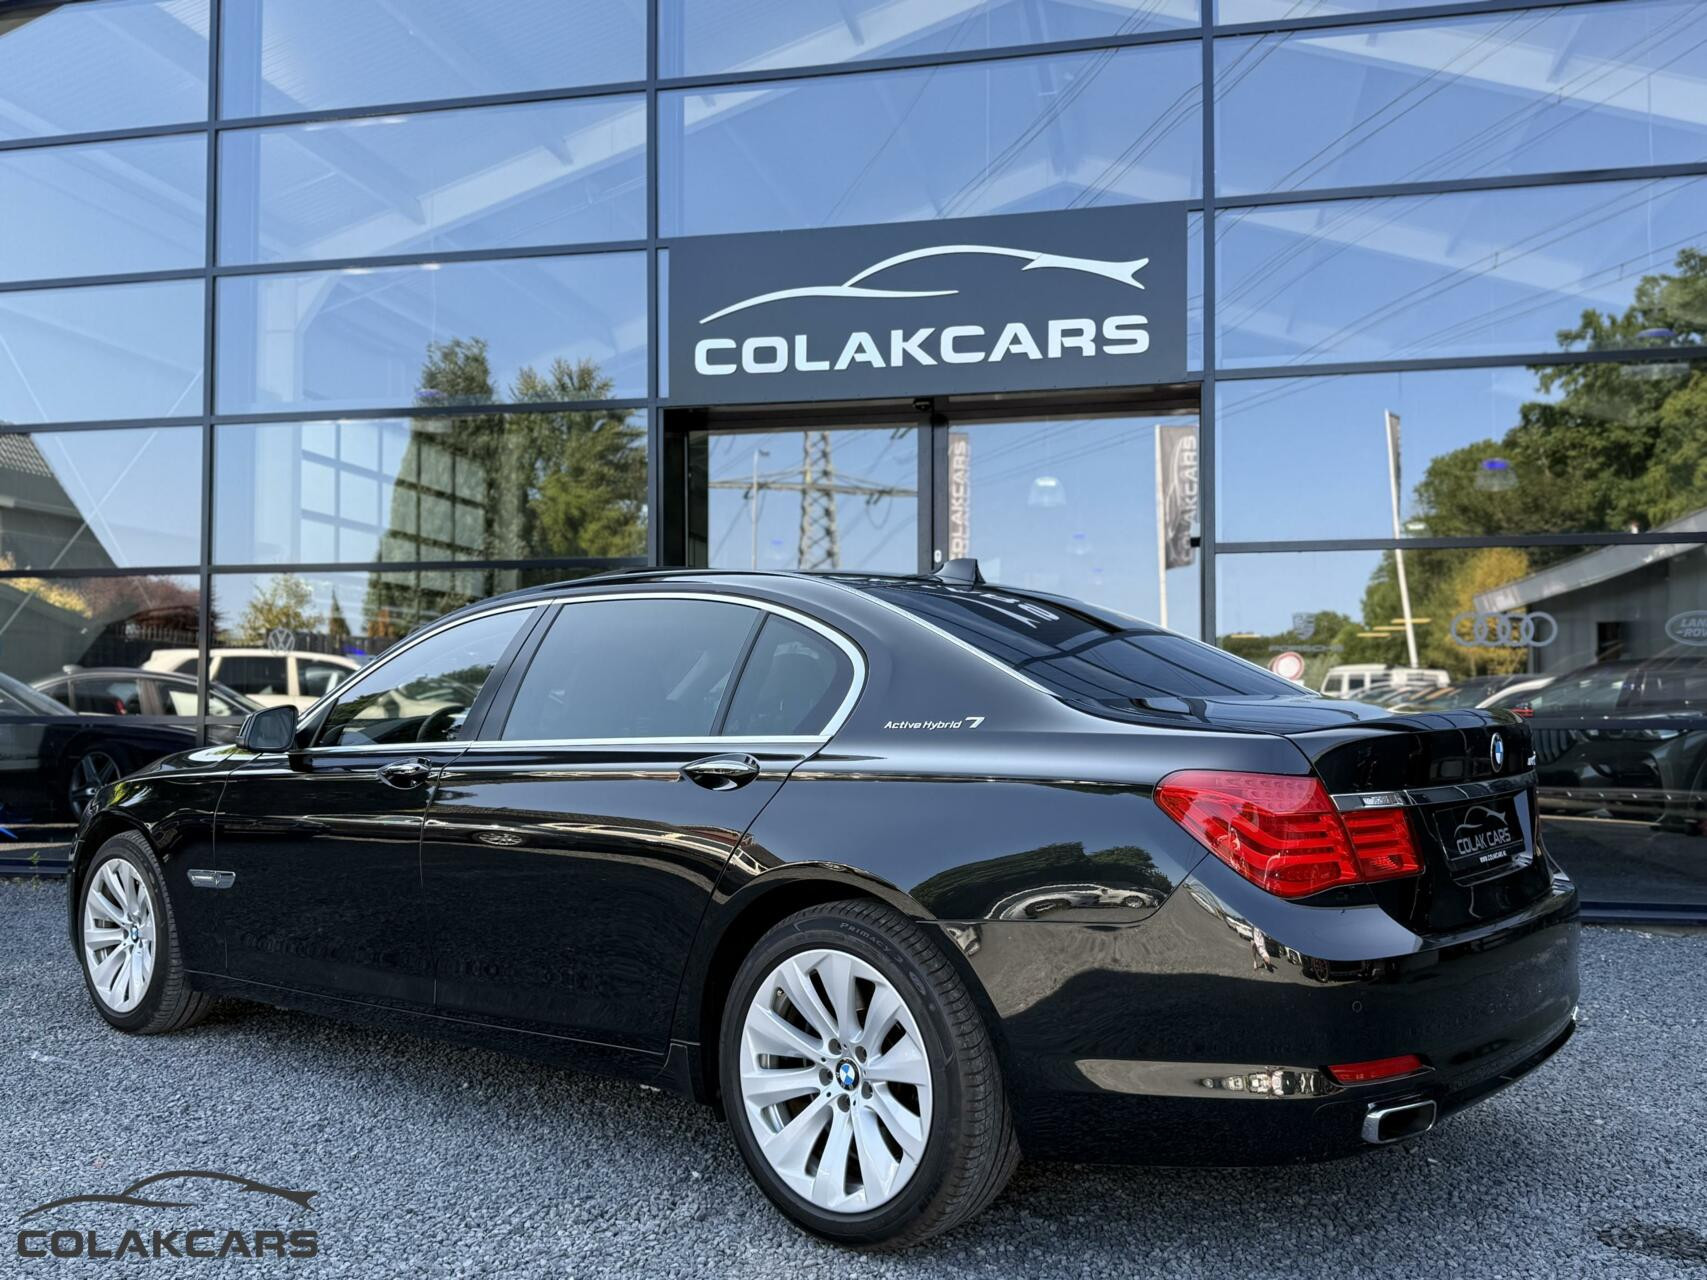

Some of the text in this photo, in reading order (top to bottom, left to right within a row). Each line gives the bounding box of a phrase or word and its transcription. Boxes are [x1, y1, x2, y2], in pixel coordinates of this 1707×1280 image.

[694, 314, 1149, 376] COLAKCARS
[1680, 618, 1707, 627] LAN
[1683, 628, 1707, 637] ROV
[965, 716, 985, 729] 7
[1456, 827, 1511, 855] COLAK CARS
